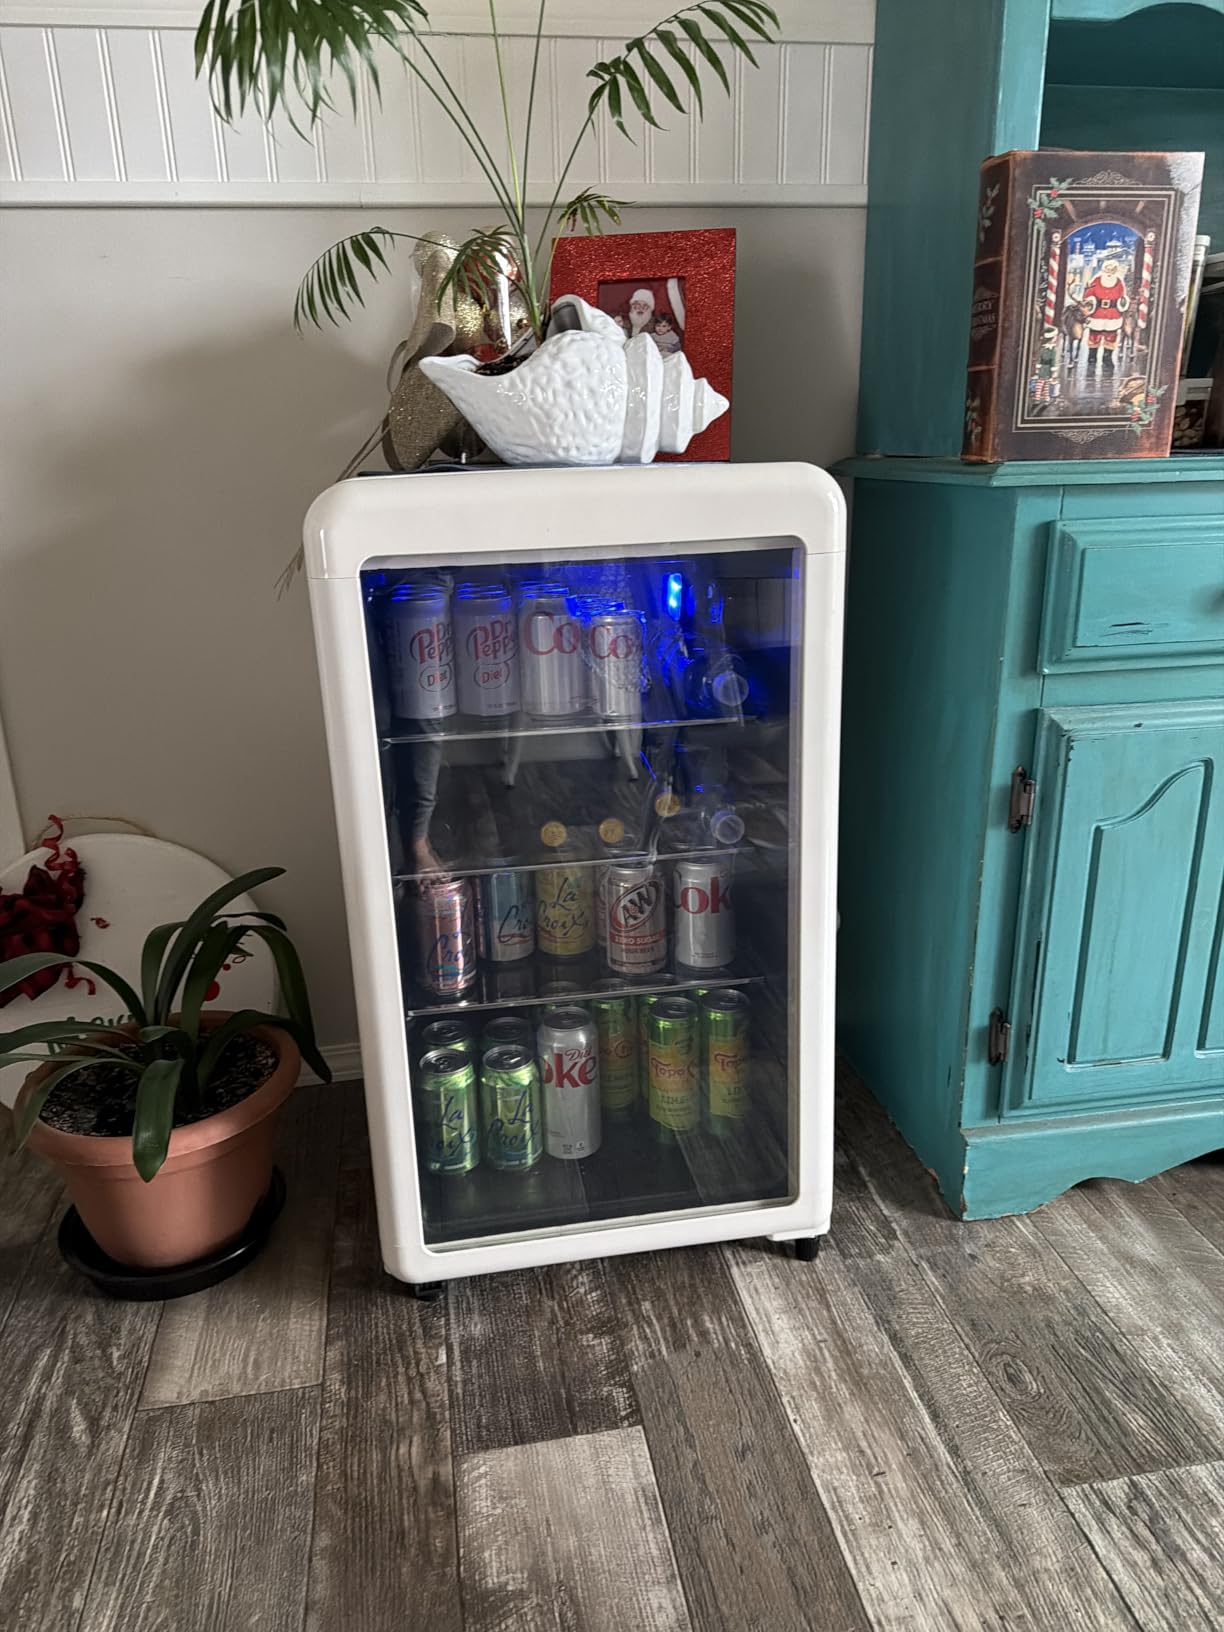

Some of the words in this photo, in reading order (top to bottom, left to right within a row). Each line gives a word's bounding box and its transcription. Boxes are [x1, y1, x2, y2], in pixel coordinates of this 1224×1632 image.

[490, 620, 511, 641] Dr
[481, 669, 502, 684] Diet
[551, 876, 578, 912] La
[650, 1057, 684, 1078] Topo
[439, 1096, 463, 1130] La
[508, 1091, 534, 1124] La
